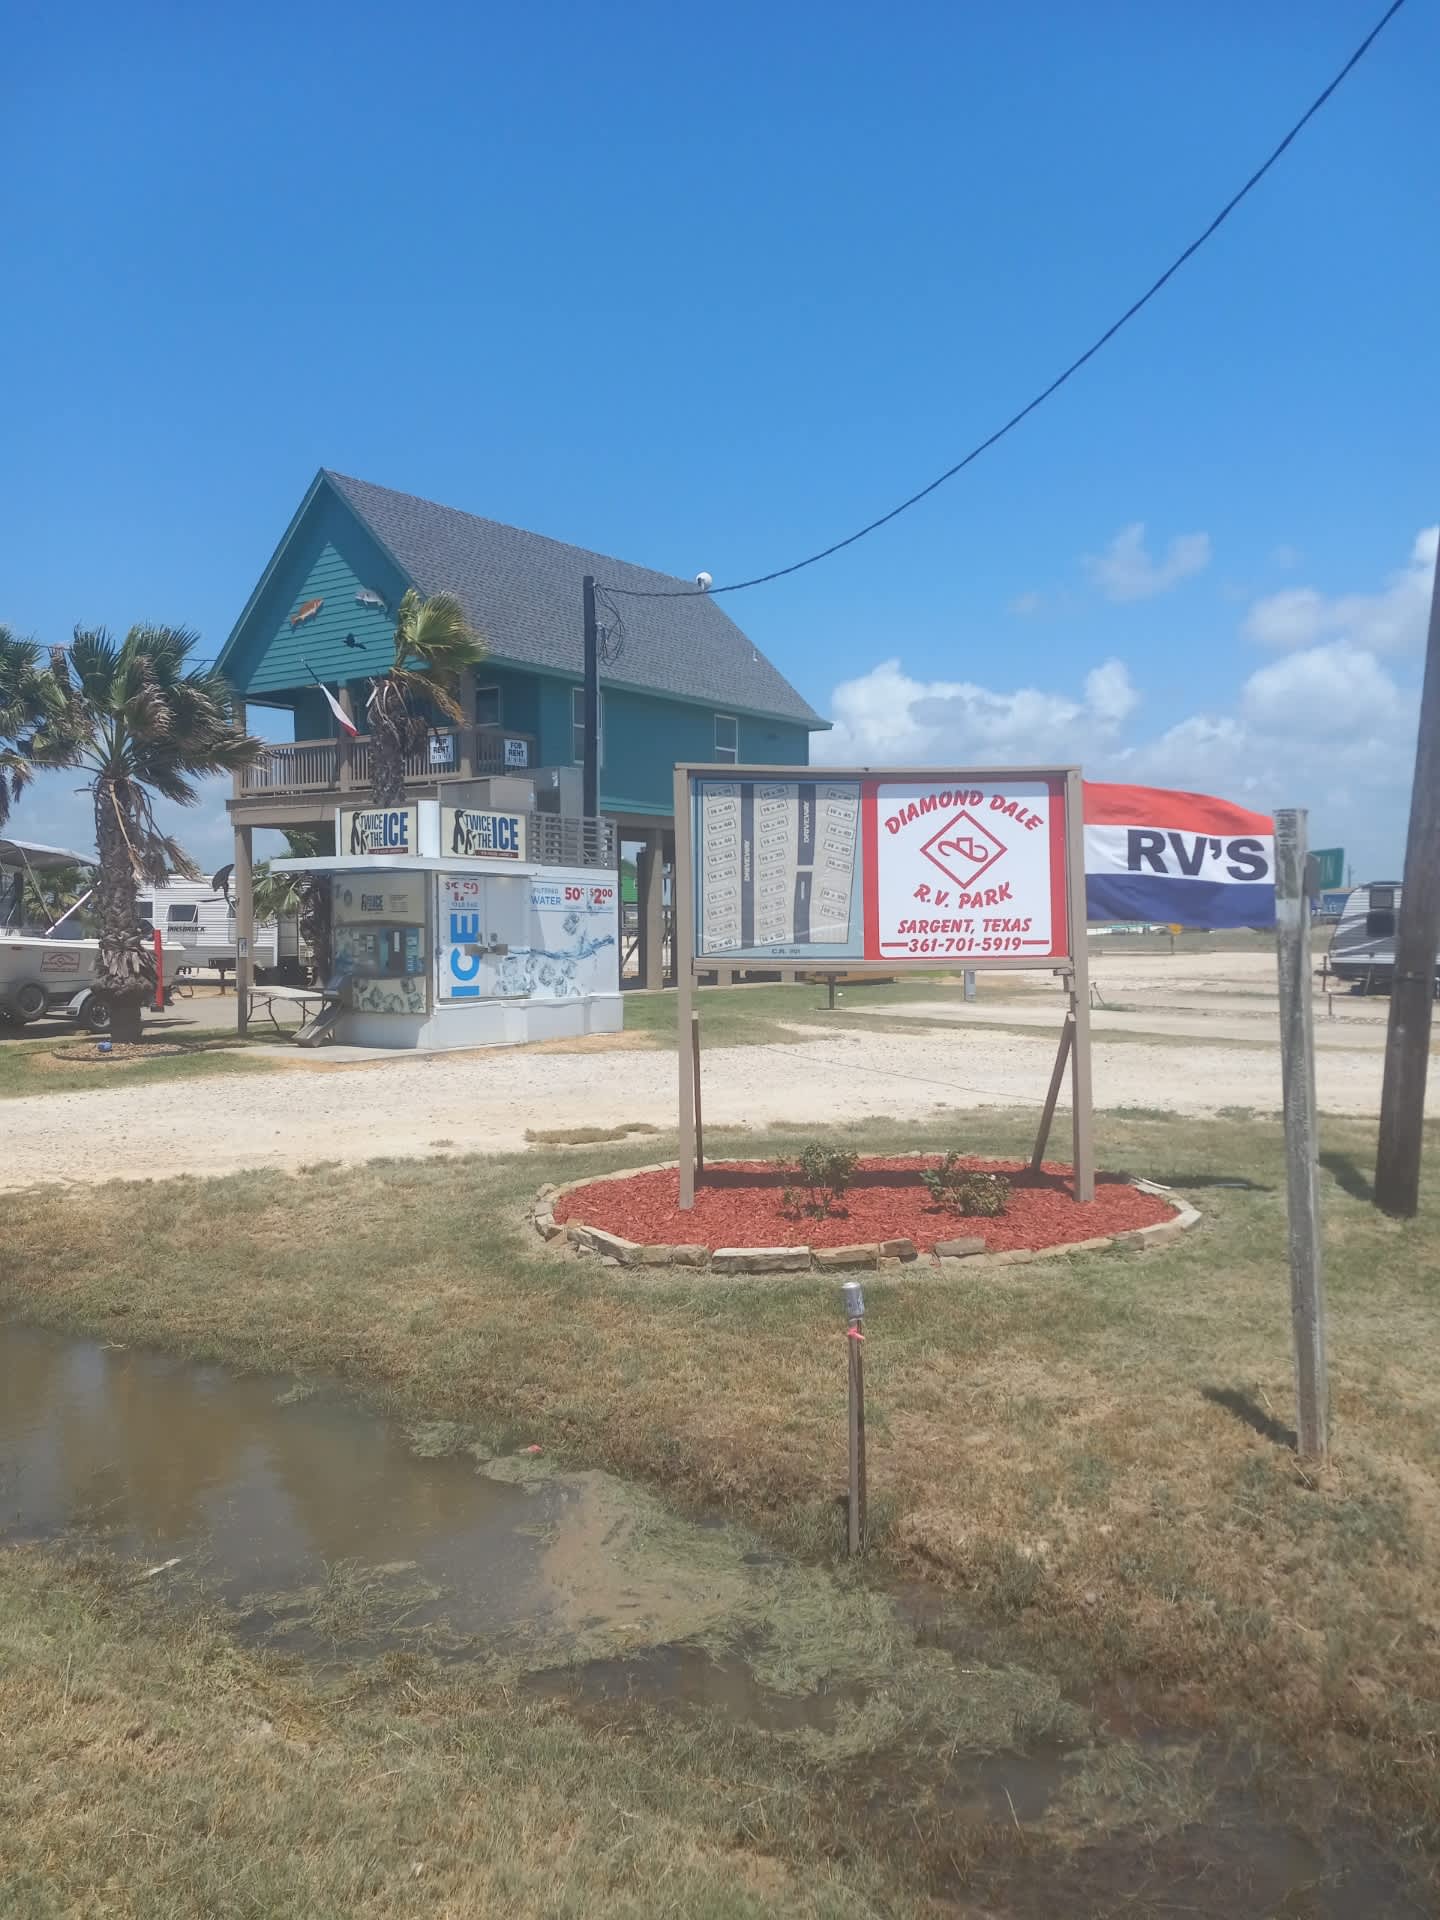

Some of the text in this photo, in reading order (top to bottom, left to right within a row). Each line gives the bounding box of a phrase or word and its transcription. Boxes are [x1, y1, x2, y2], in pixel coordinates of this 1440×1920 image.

[360, 813, 383, 830] TWICE
[884, 790, 1044, 835] DIAMOND DALE
[383, 812, 409, 847] ICE
[464, 814, 491, 831] TWICE
[369, 831, 383, 847] THE
[477, 833, 492, 848] THE
[491, 816, 519, 850] ICE
[1127, 829, 1269, 881] RV'S
[531, 895, 562, 906] WATER
[913, 881, 1014, 909] R.V. PARK
[897, 917, 1033, 935] SARGENT, TEXAS
[908, 936, 1023, 953] 361-701-5919
[449, 913, 481, 998] ICE
